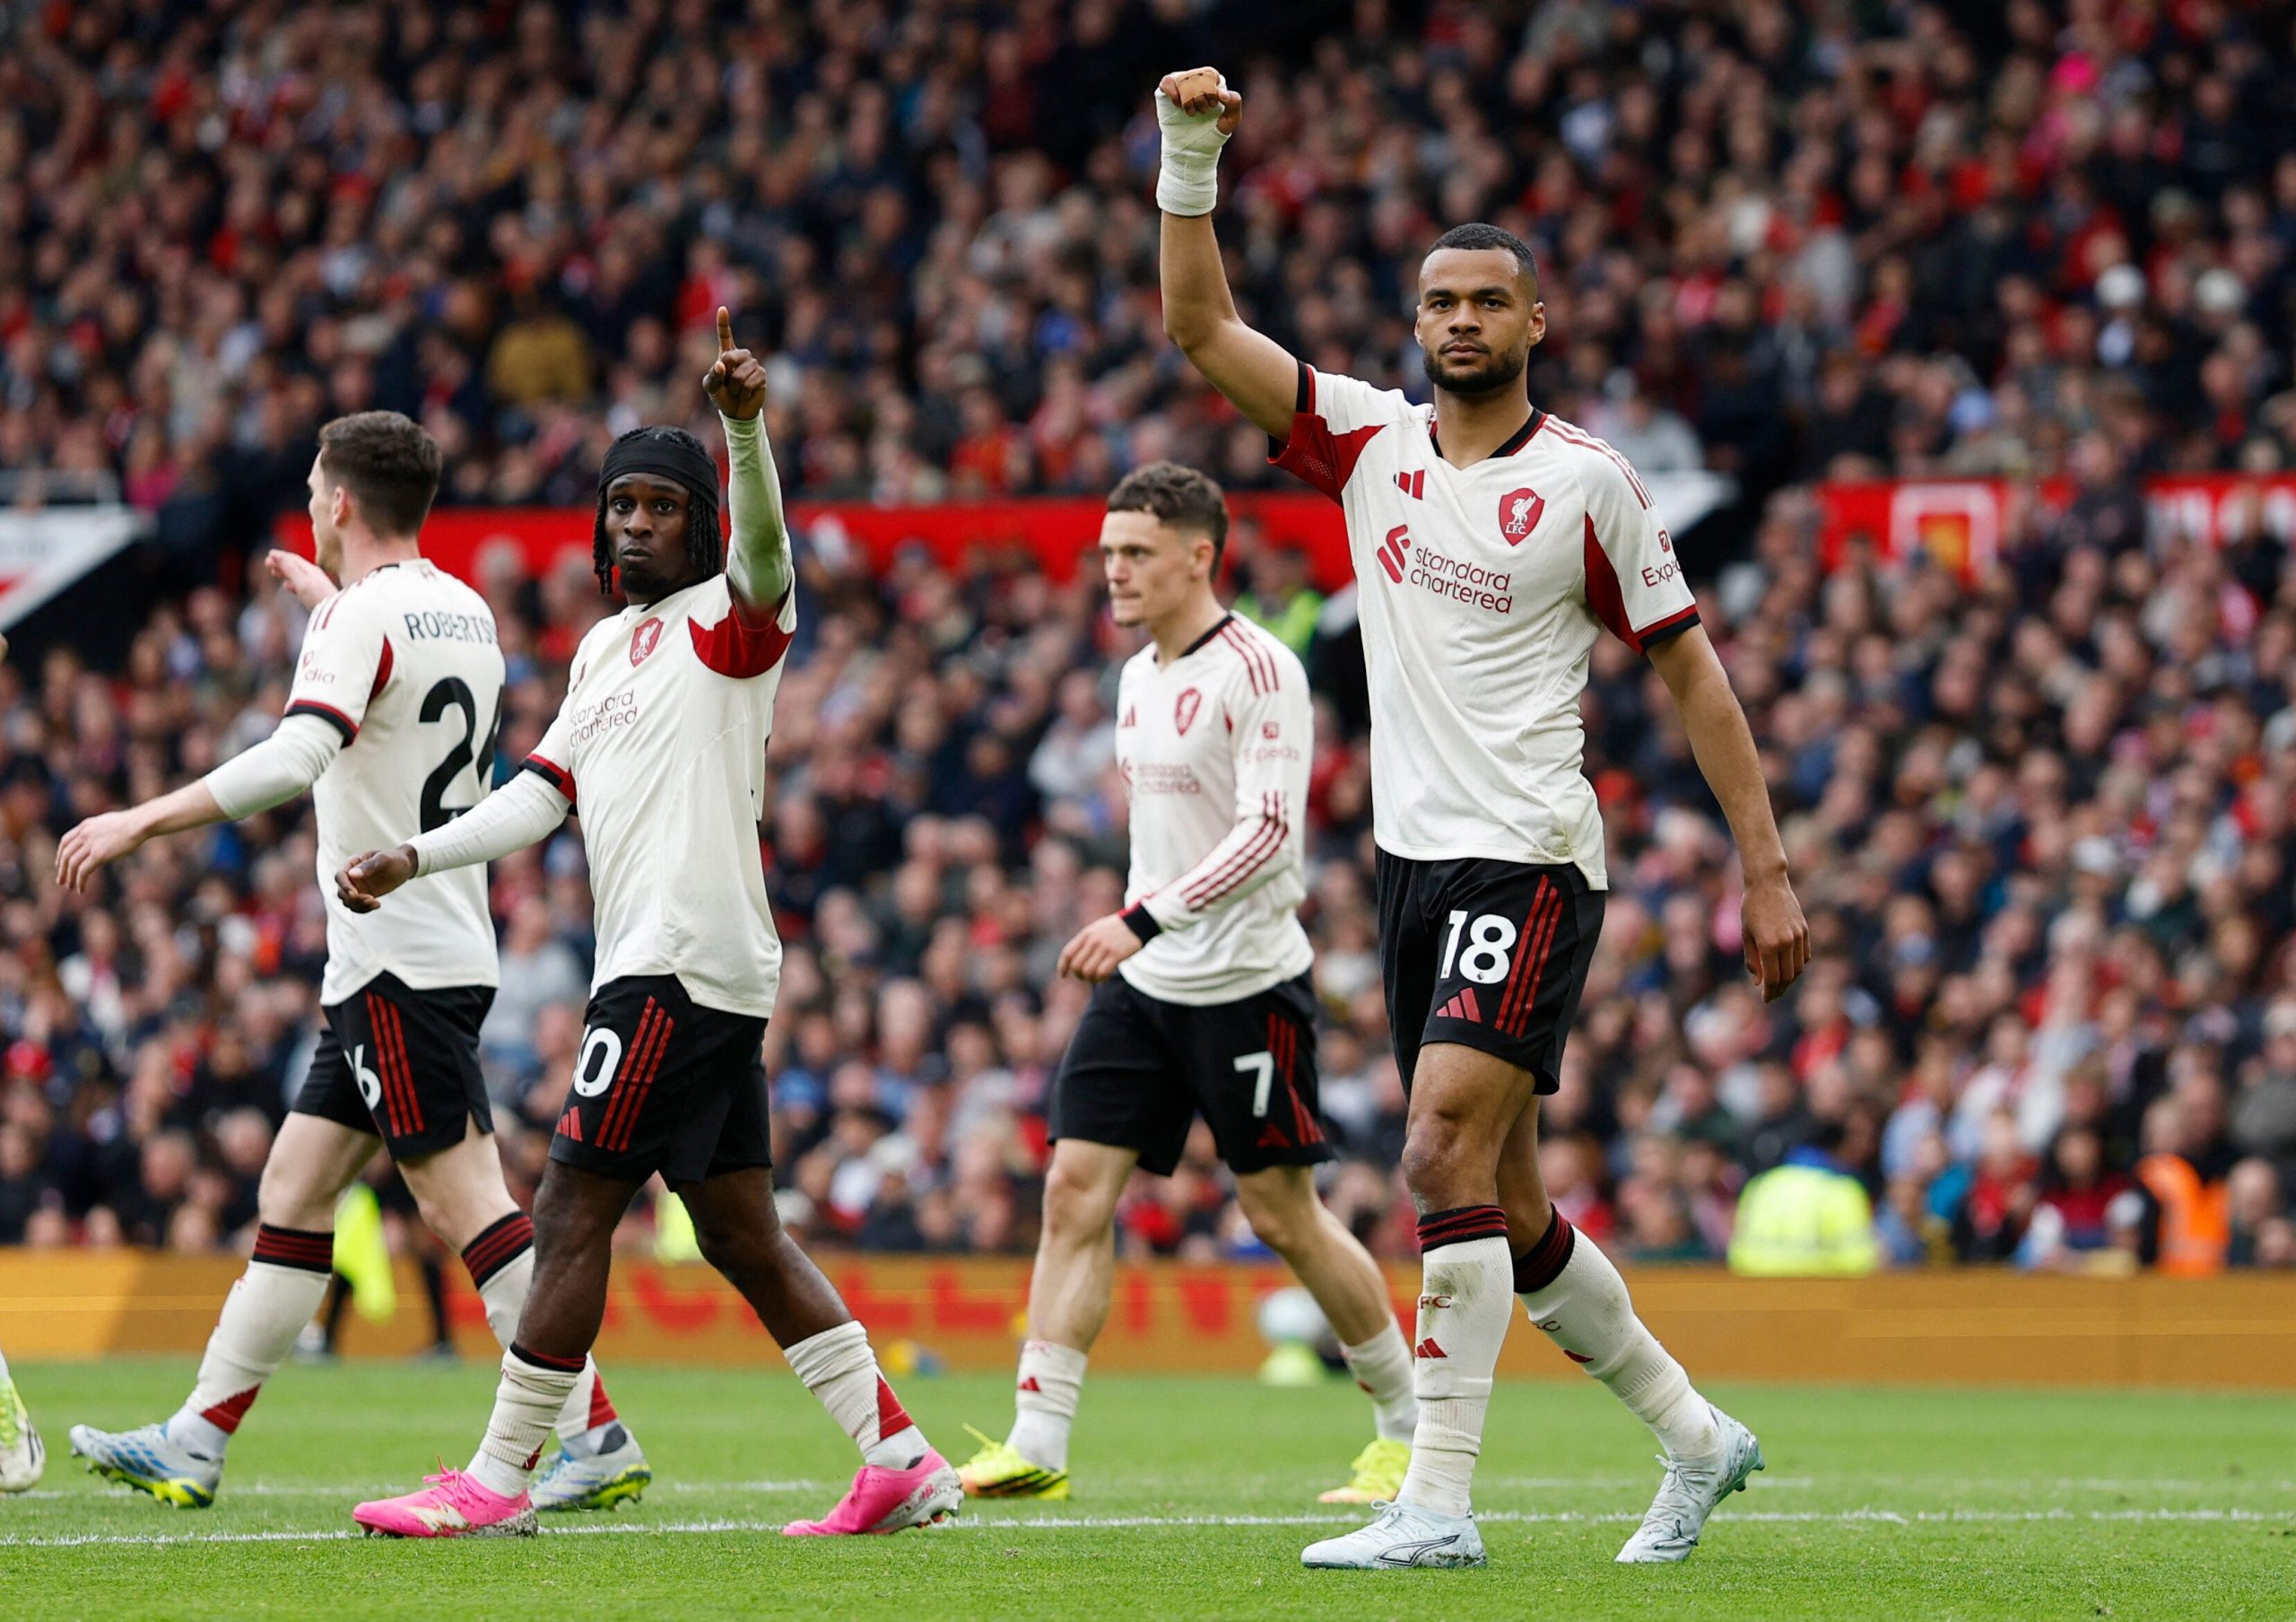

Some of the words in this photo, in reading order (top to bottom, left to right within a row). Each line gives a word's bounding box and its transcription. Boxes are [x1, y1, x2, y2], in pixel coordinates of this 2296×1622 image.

[1505, 524, 1527, 535] LFC
[1410, 568, 1513, 615] chartered
[1415, 546, 1511, 592] standard
[1439, 910, 1518, 985] 18
[343, 1042, 382, 1112] 6
[1232, 1050, 1274, 1118] 7
